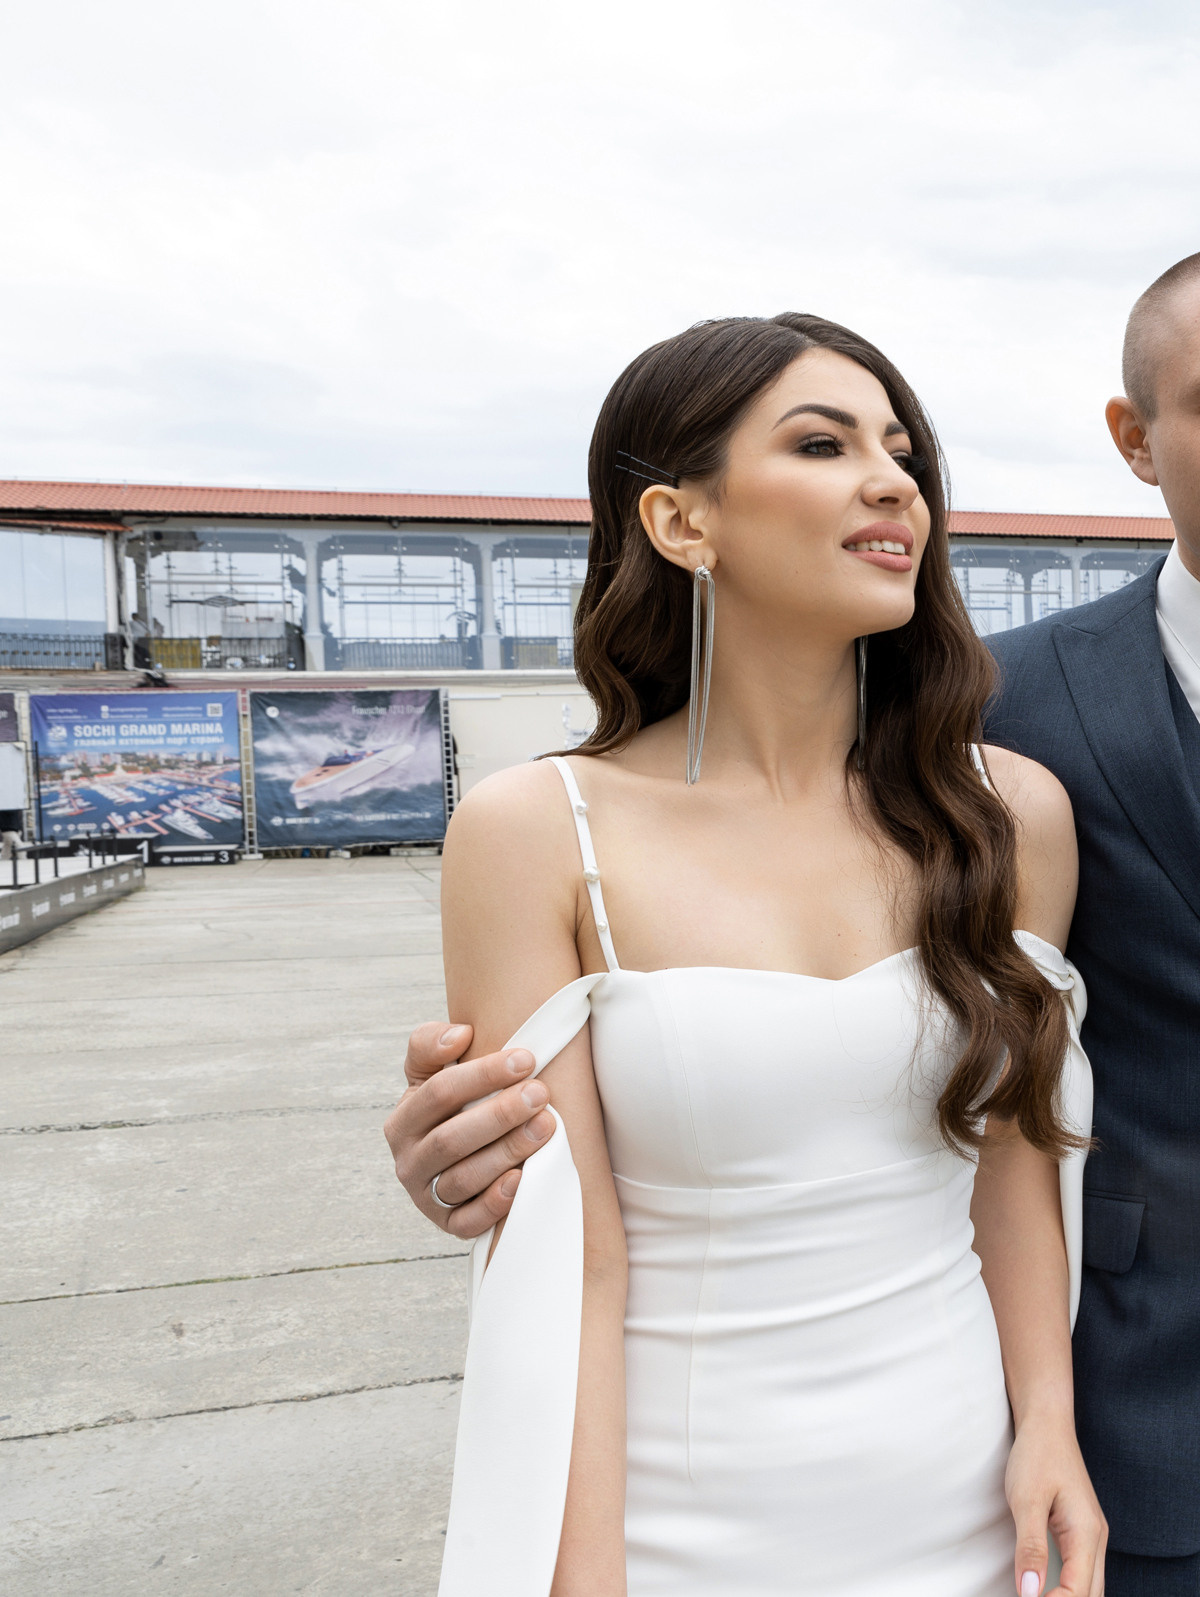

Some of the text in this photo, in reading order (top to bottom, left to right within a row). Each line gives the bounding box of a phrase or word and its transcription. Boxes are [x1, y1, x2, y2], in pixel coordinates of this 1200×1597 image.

[73, 722, 224, 738] SOCHI GRAND MARINA
[136, 840, 149, 864] 1
[218, 850, 230, 864] 3
